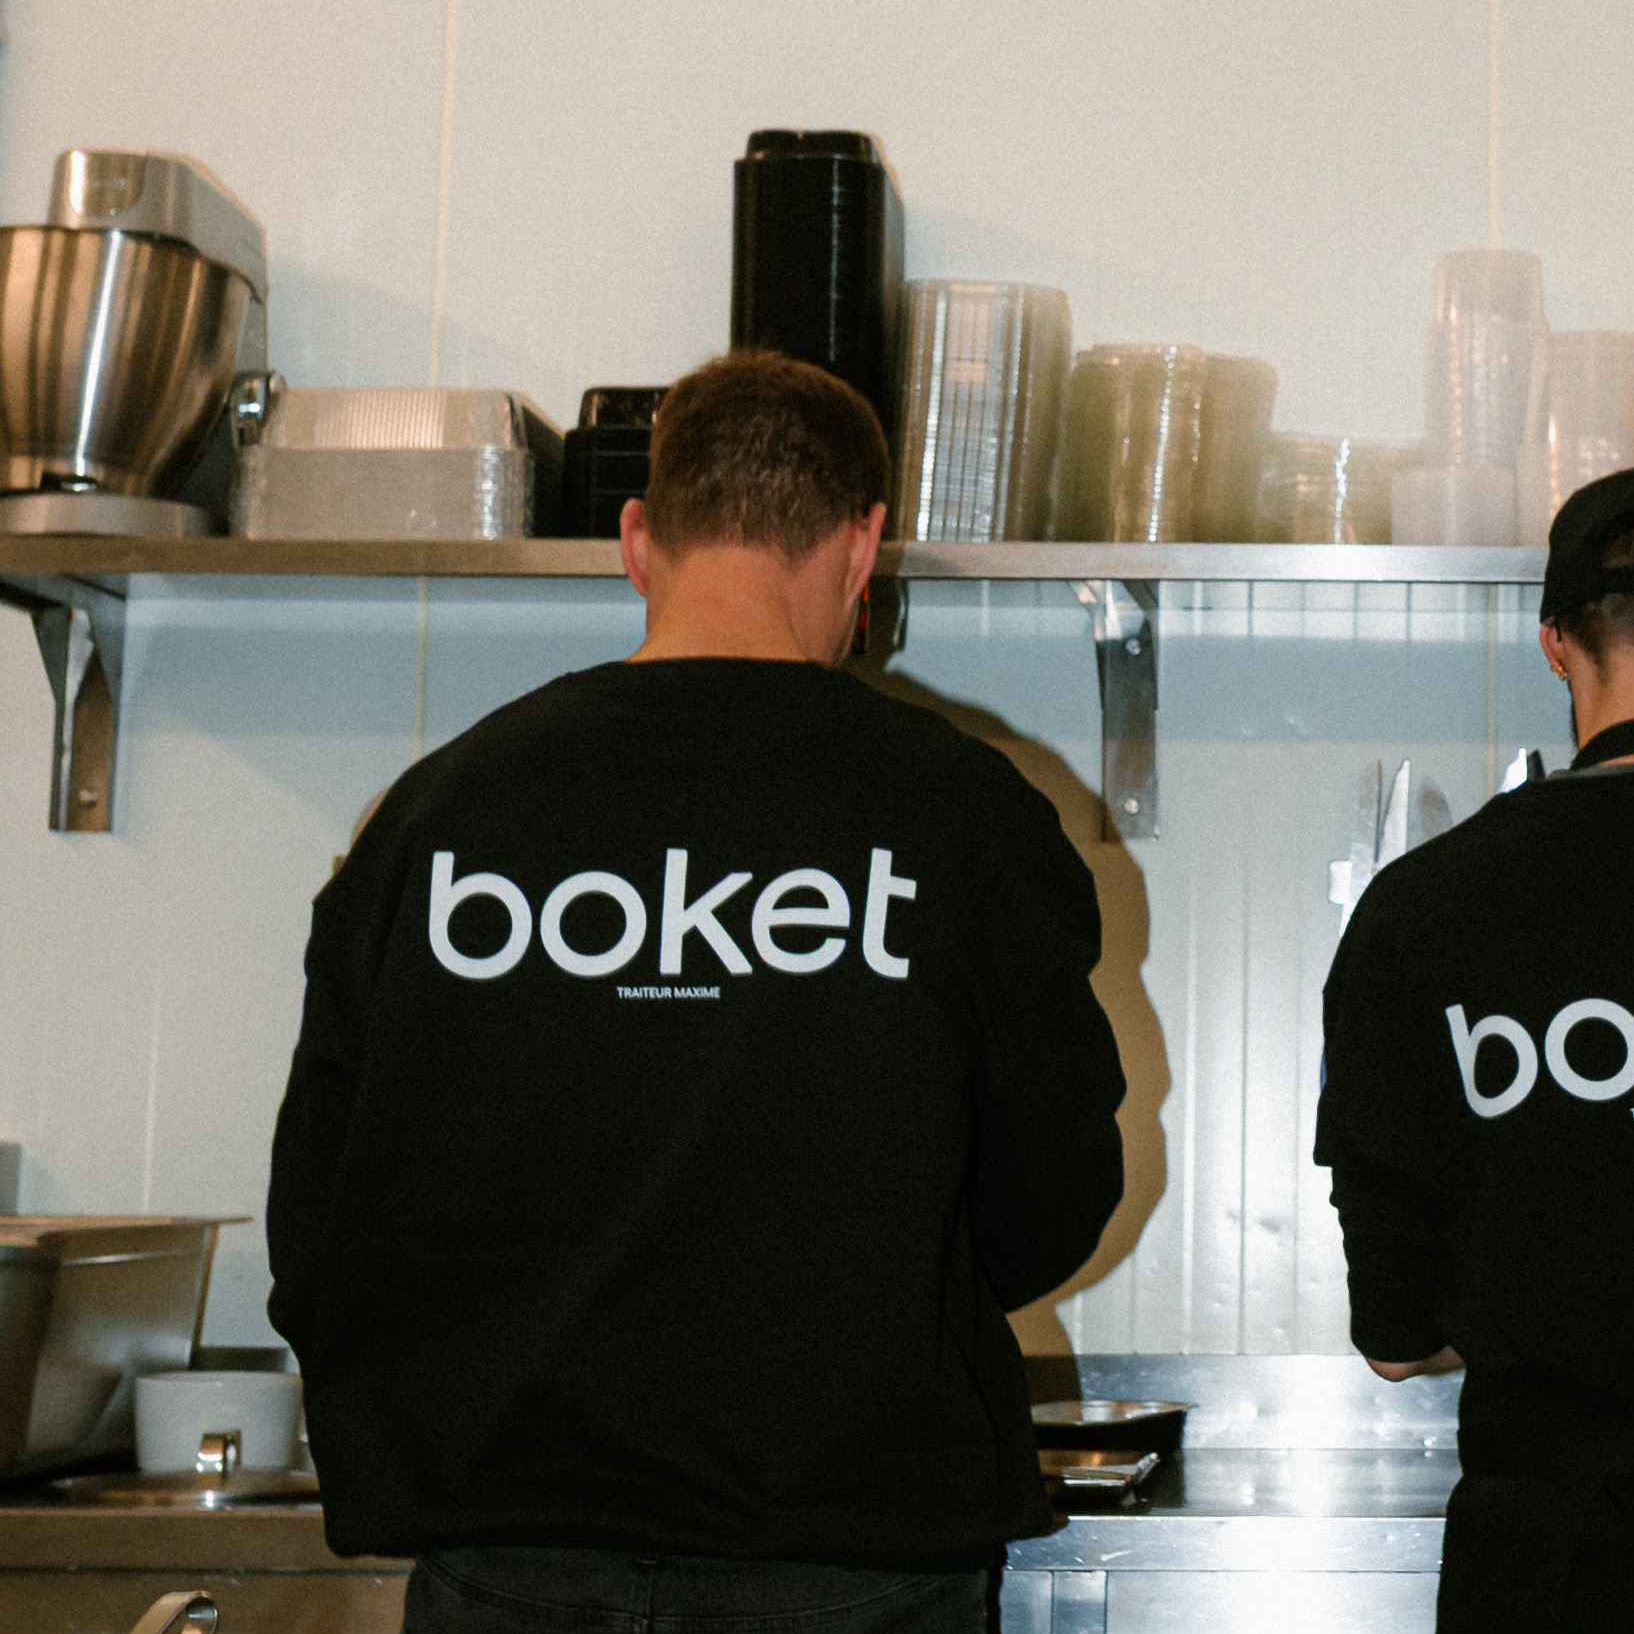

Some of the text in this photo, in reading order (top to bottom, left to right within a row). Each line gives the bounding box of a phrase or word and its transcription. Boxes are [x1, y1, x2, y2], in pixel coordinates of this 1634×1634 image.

[429, 847, 917, 980] boket
[616, 986, 721, 999] TRAITEUR MAXIME
